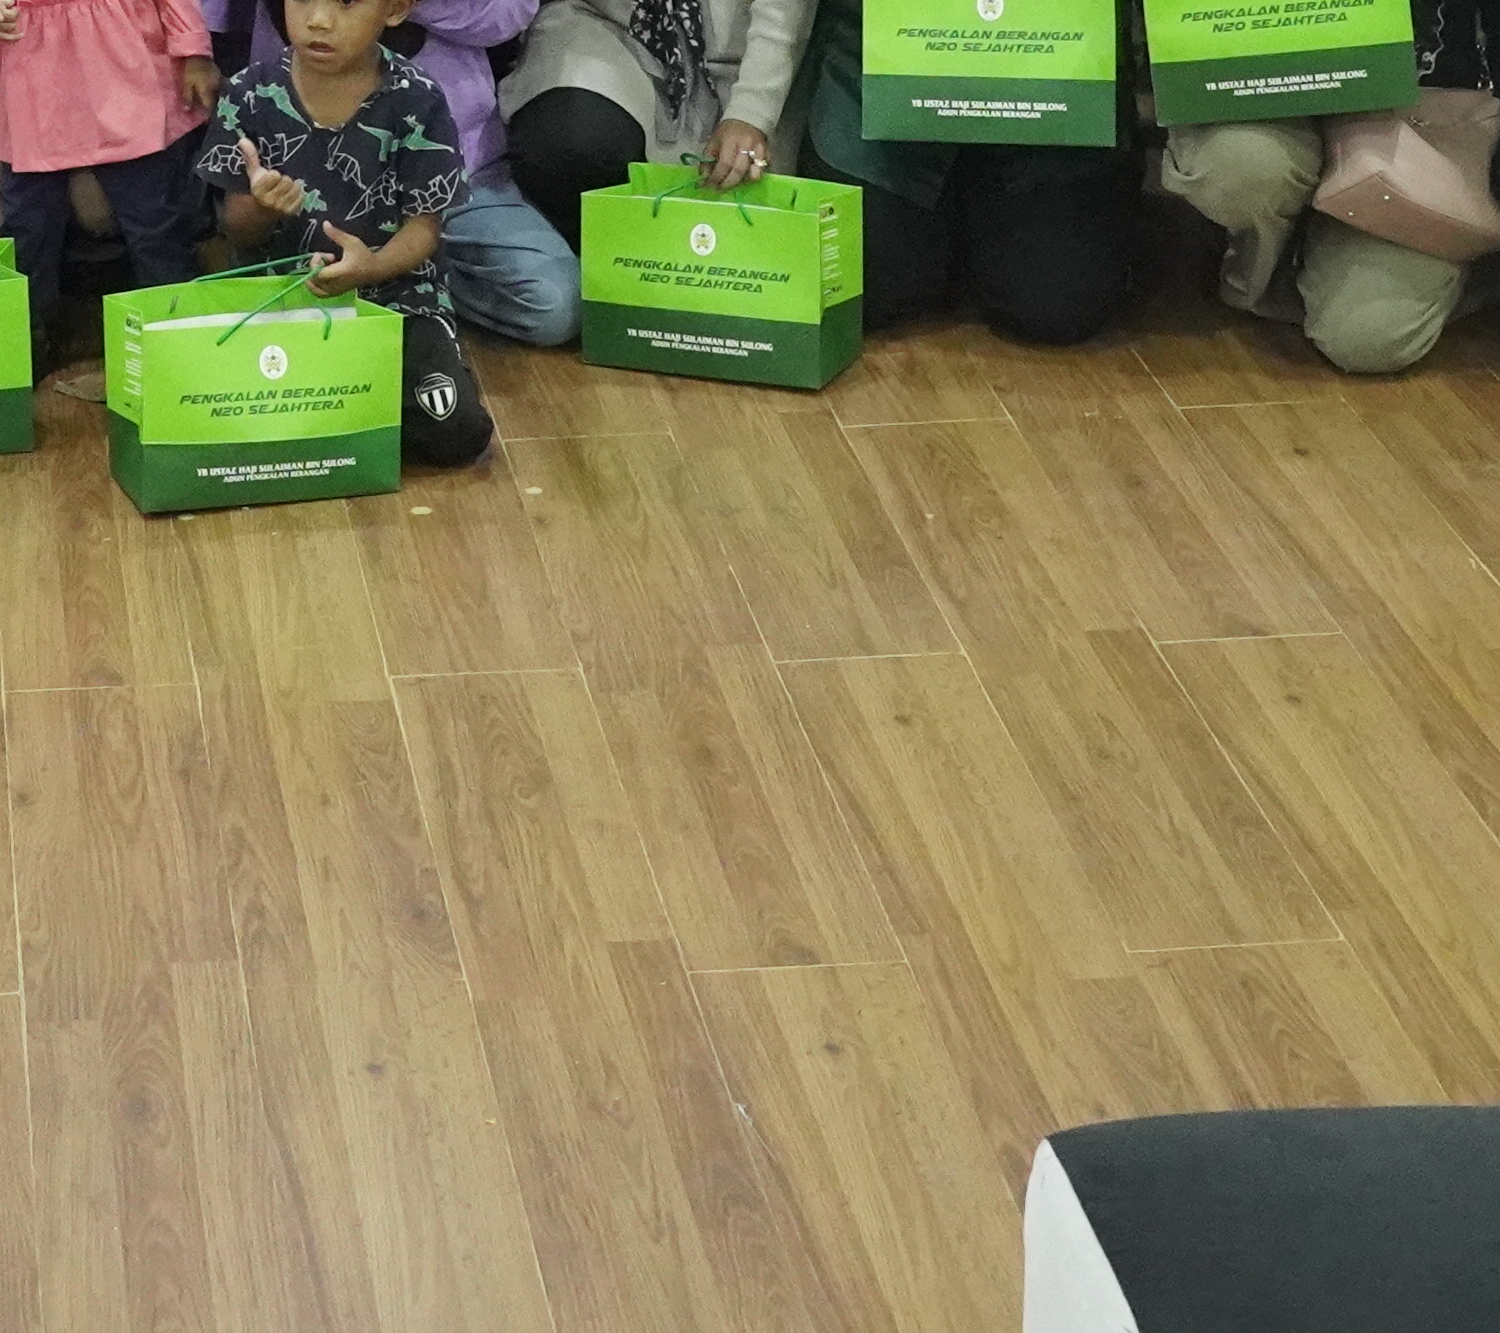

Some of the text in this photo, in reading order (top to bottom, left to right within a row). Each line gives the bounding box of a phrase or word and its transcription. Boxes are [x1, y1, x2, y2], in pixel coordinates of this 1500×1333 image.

[1180, 4, 1280, 22] PENGKALAN
[1250, 11, 1348, 30] SEJAHTERA
[896, 27, 1085, 41] PENGKALAN BERANGAN
[960, 42, 1054, 54] SEJAHTERA
[178, 382, 372, 405] PENGKALAN BERANGAN
[248, 398, 351, 415] SEJAHTERA
